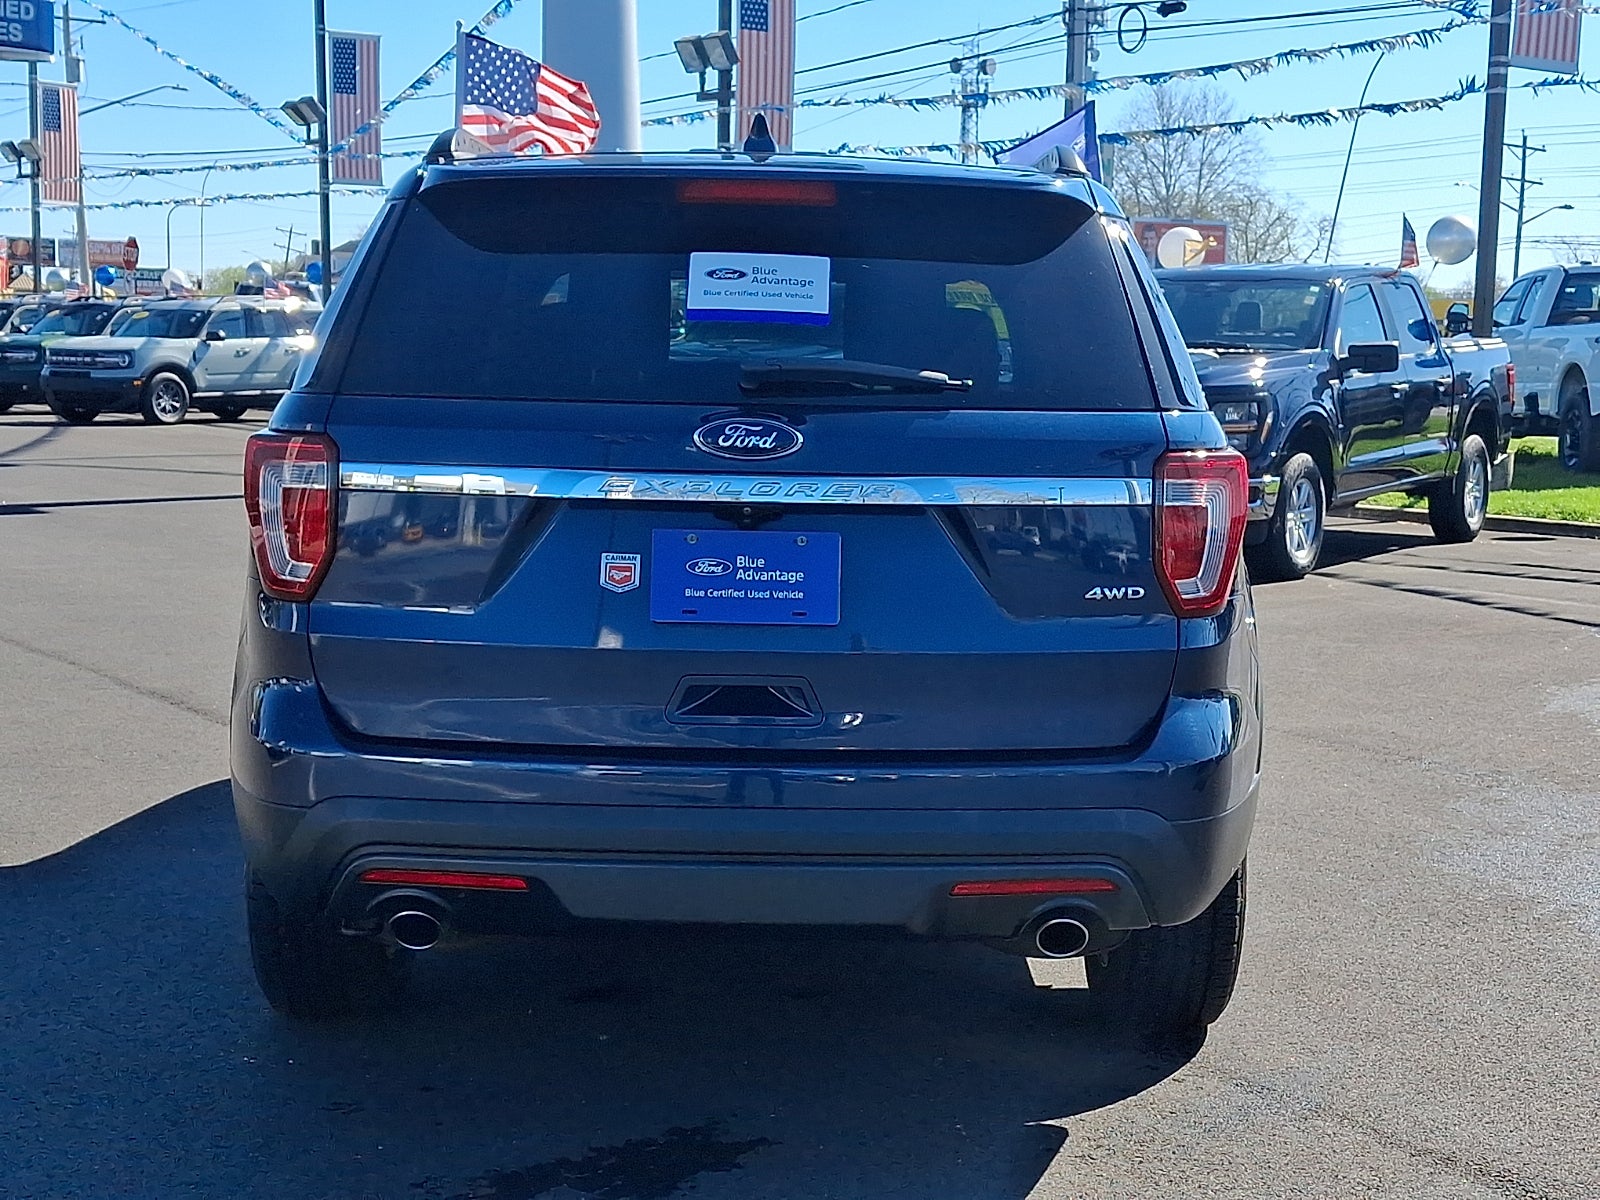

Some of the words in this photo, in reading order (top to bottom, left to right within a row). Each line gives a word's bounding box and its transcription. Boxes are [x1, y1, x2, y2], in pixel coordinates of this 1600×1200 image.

[712, 267, 740, 279] Ford
[752, 266, 778, 276] Blue
[751, 276, 815, 288] Advantage
[703, 289, 722, 297] Blue
[785, 292, 814, 300] Vehicle
[718, 424, 777, 449] Ford
[596, 477, 897, 499] EXPLORER
[605, 554, 638, 562] CARMAN
[736, 555, 766, 568] Blue
[694, 559, 725, 573] Ford
[735, 569, 805, 583] Advantage
[684, 588, 705, 597] Blue
[707, 588, 745, 598] Certified
[747, 589, 770, 599] Used
[772, 590, 804, 599] Vehicle
[1084, 586, 1145, 600] 4WD
